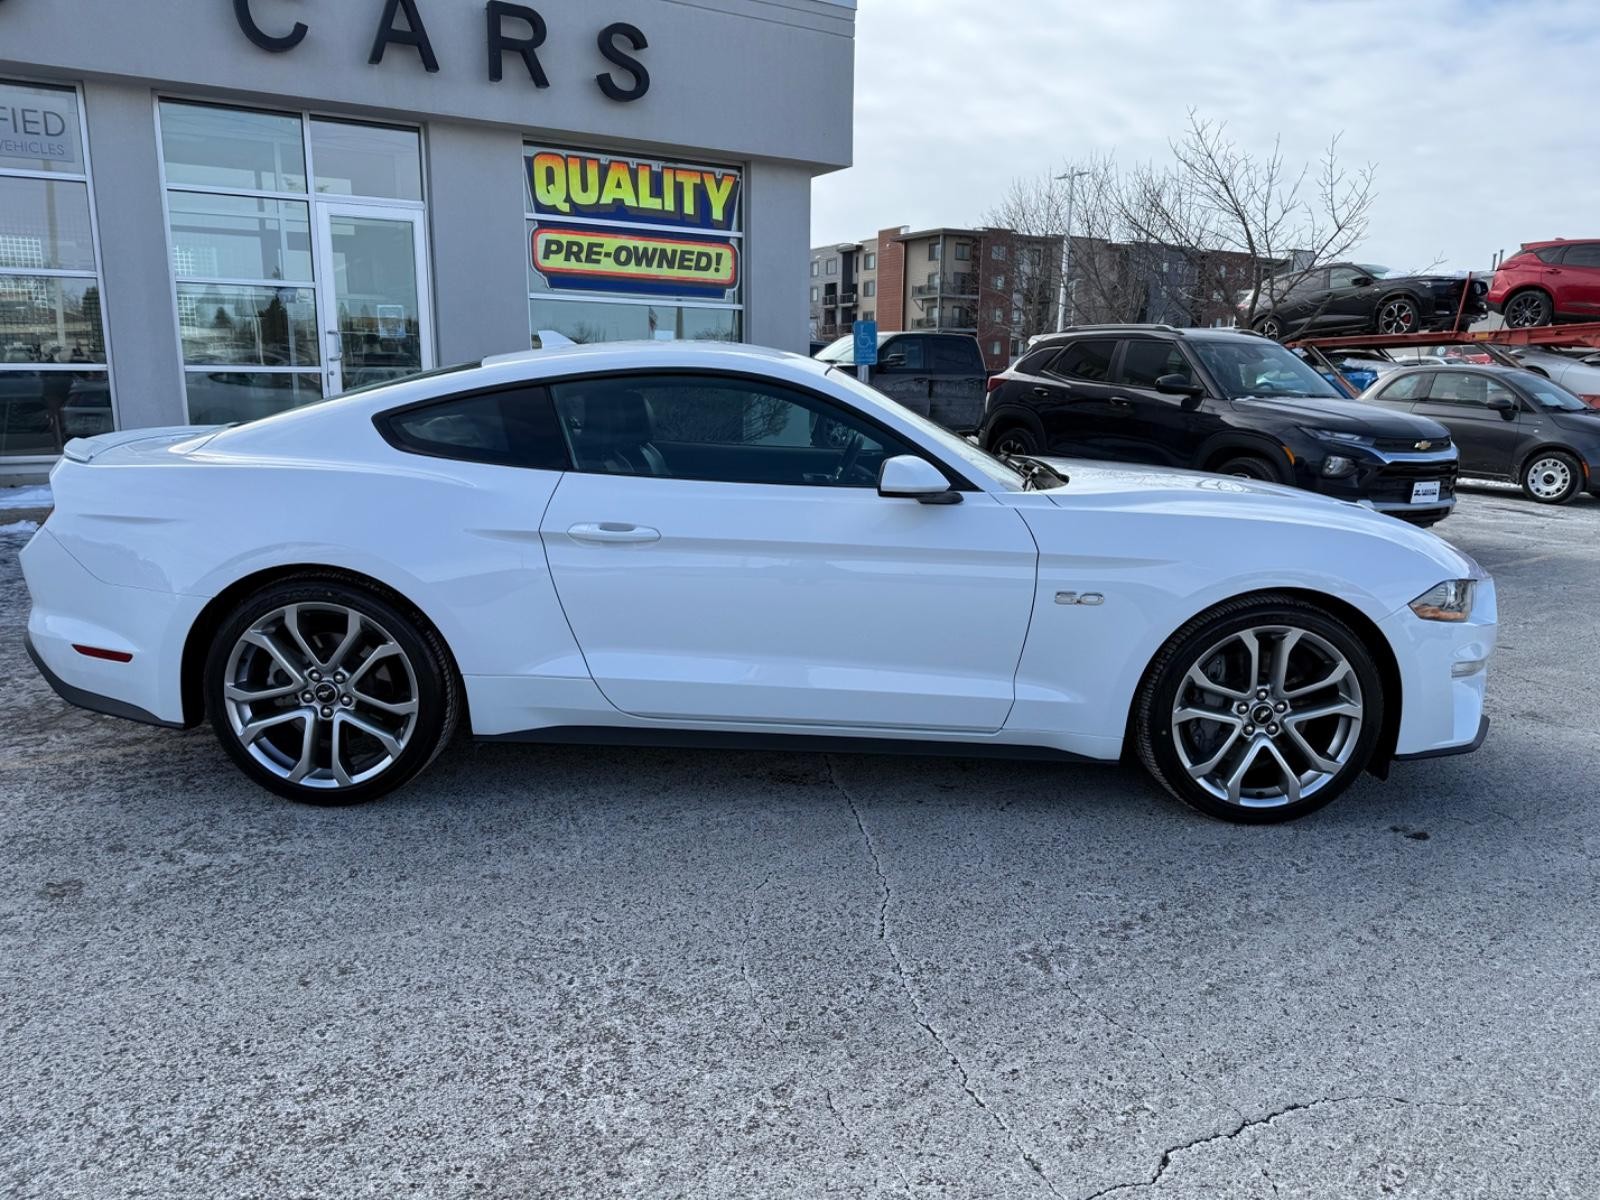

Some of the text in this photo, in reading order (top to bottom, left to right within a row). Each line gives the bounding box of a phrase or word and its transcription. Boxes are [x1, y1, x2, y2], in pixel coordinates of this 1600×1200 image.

[233, 0, 650, 101] CARS
[532, 152, 736, 222] QUALITY
[541, 238, 724, 273] PRE-OWNED!
